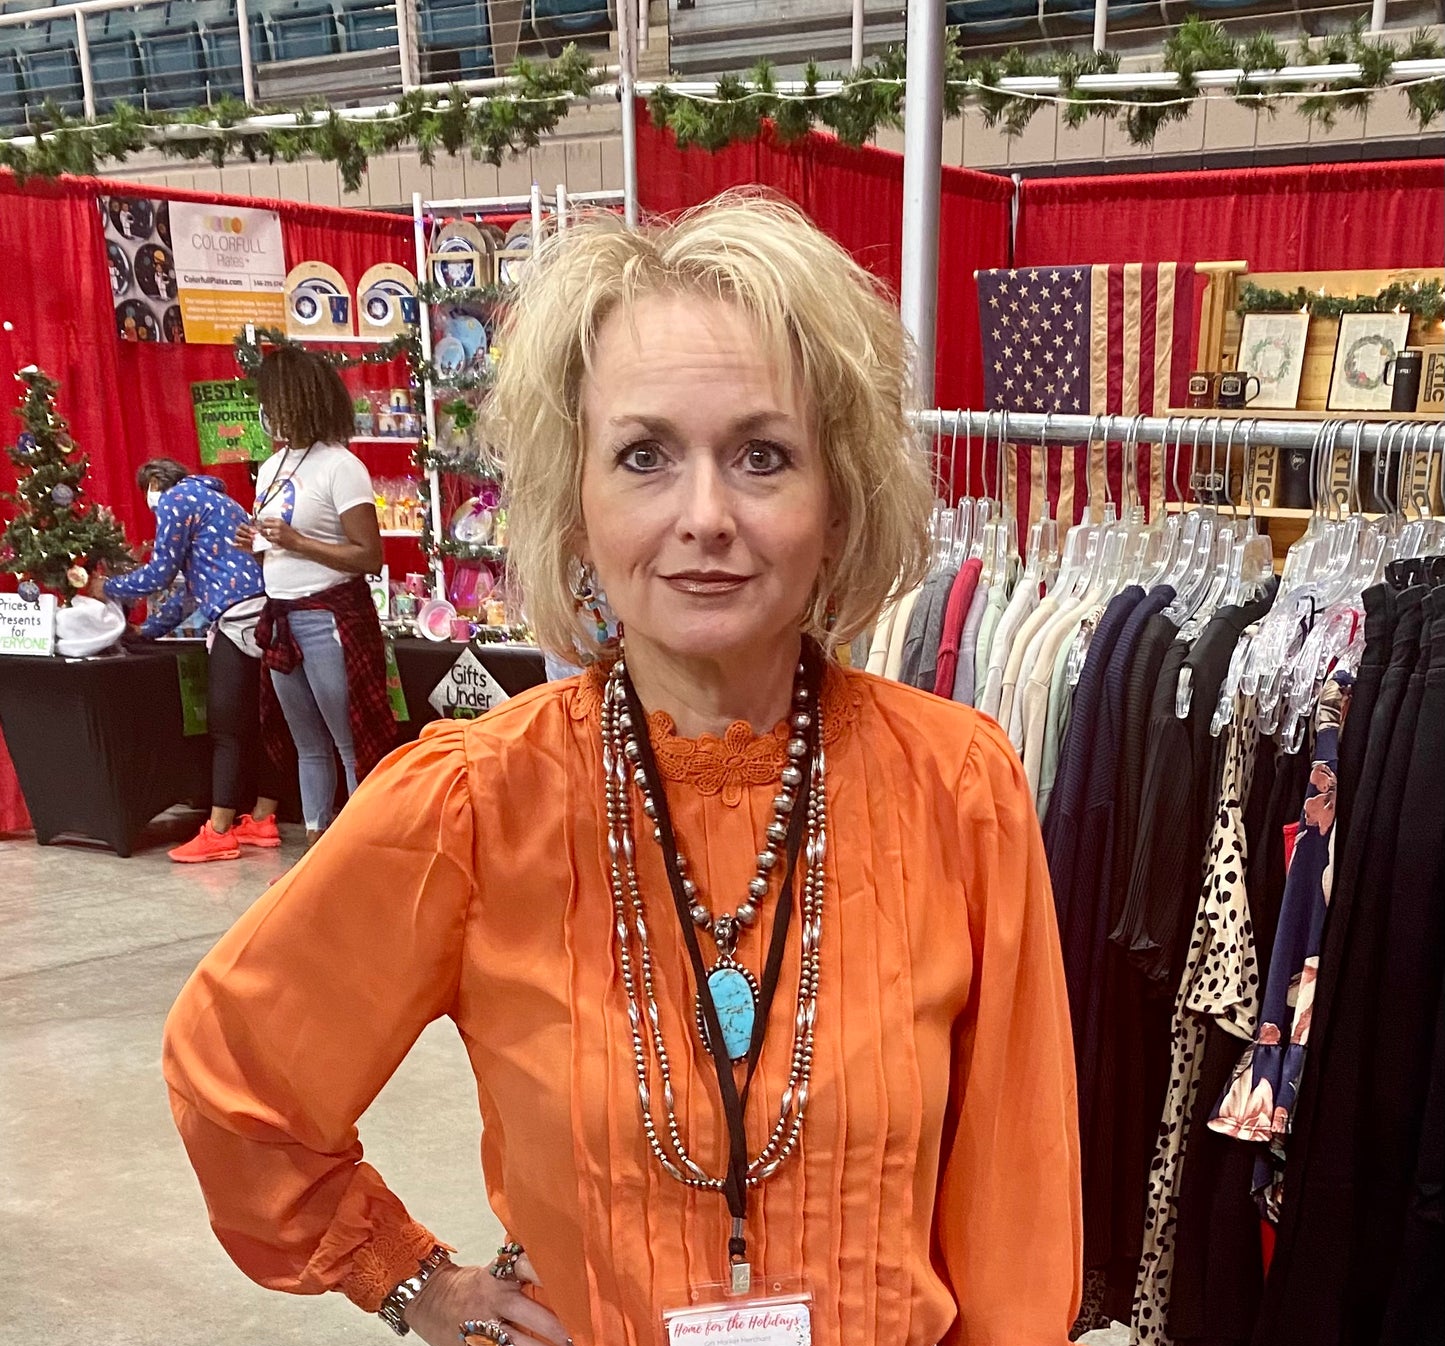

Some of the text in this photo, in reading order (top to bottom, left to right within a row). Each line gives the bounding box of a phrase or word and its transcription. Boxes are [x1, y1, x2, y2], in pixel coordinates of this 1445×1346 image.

[192, 233, 266, 254] COLORFULL
[216, 254, 244, 267] Plates
[192, 383, 236, 404] BEST
[202, 411, 260, 423] FAVORITE
[11, 625, 26, 638] for
[451, 664, 487, 688] Gifts
[446, 685, 492, 708] Under
[674, 1311, 800, 1338] Home for the Holidays
